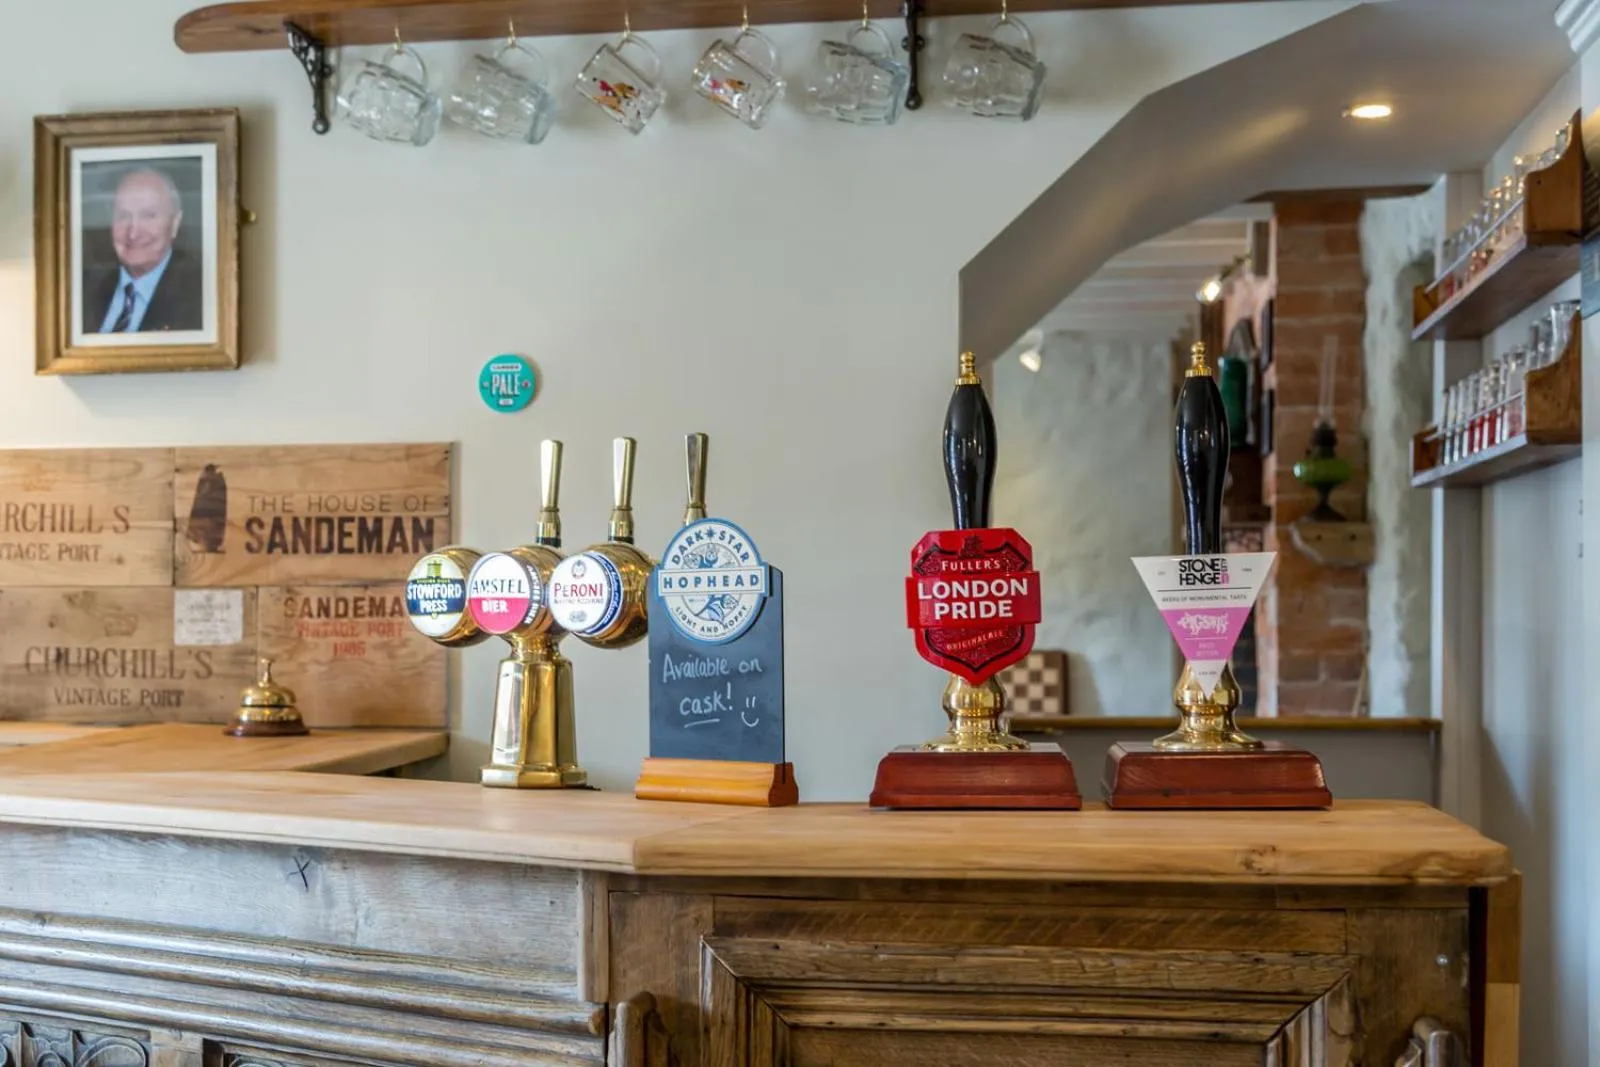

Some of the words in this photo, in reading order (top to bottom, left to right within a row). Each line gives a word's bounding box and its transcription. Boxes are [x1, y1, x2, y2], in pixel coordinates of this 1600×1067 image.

[491, 373, 520, 396] PALE
[249, 495, 294, 513] THE
[308, 494, 391, 513] HOUSE
[404, 494, 434, 512] OF
[0, 502, 131, 534] RCHILLS
[245, 516, 434, 555] SANDEMAN
[58, 543, 101, 562] PORT
[672, 530, 704, 565] DARK
[719, 530, 749, 562] STAR
[941, 558, 1001, 572] FULLER'S
[1179, 558, 1220, 573] STONE
[472, 578, 526, 595] AMSTEL
[663, 574, 760, 589] HOPHEAD
[917, 578, 1029, 600] LONDON
[1179, 573, 1221, 586] HENGE
[406, 583, 462, 600] STOWFORD
[553, 582, 604, 598] PERONI
[284, 596, 404, 619] SANDEMA
[420, 600, 448, 614] PRESS
[481, 600, 508, 613] BIER
[934, 600, 1014, 620] PRIDE
[700, 624, 719, 634] AND
[25, 645, 214, 680] CHURCHILL'S
[662, 653, 730, 683] Available
[739, 658, 763, 673] on
[54, 687, 130, 706] VINTAGE
[140, 688, 184, 708] PORT
[680, 681, 733, 716] cask!
